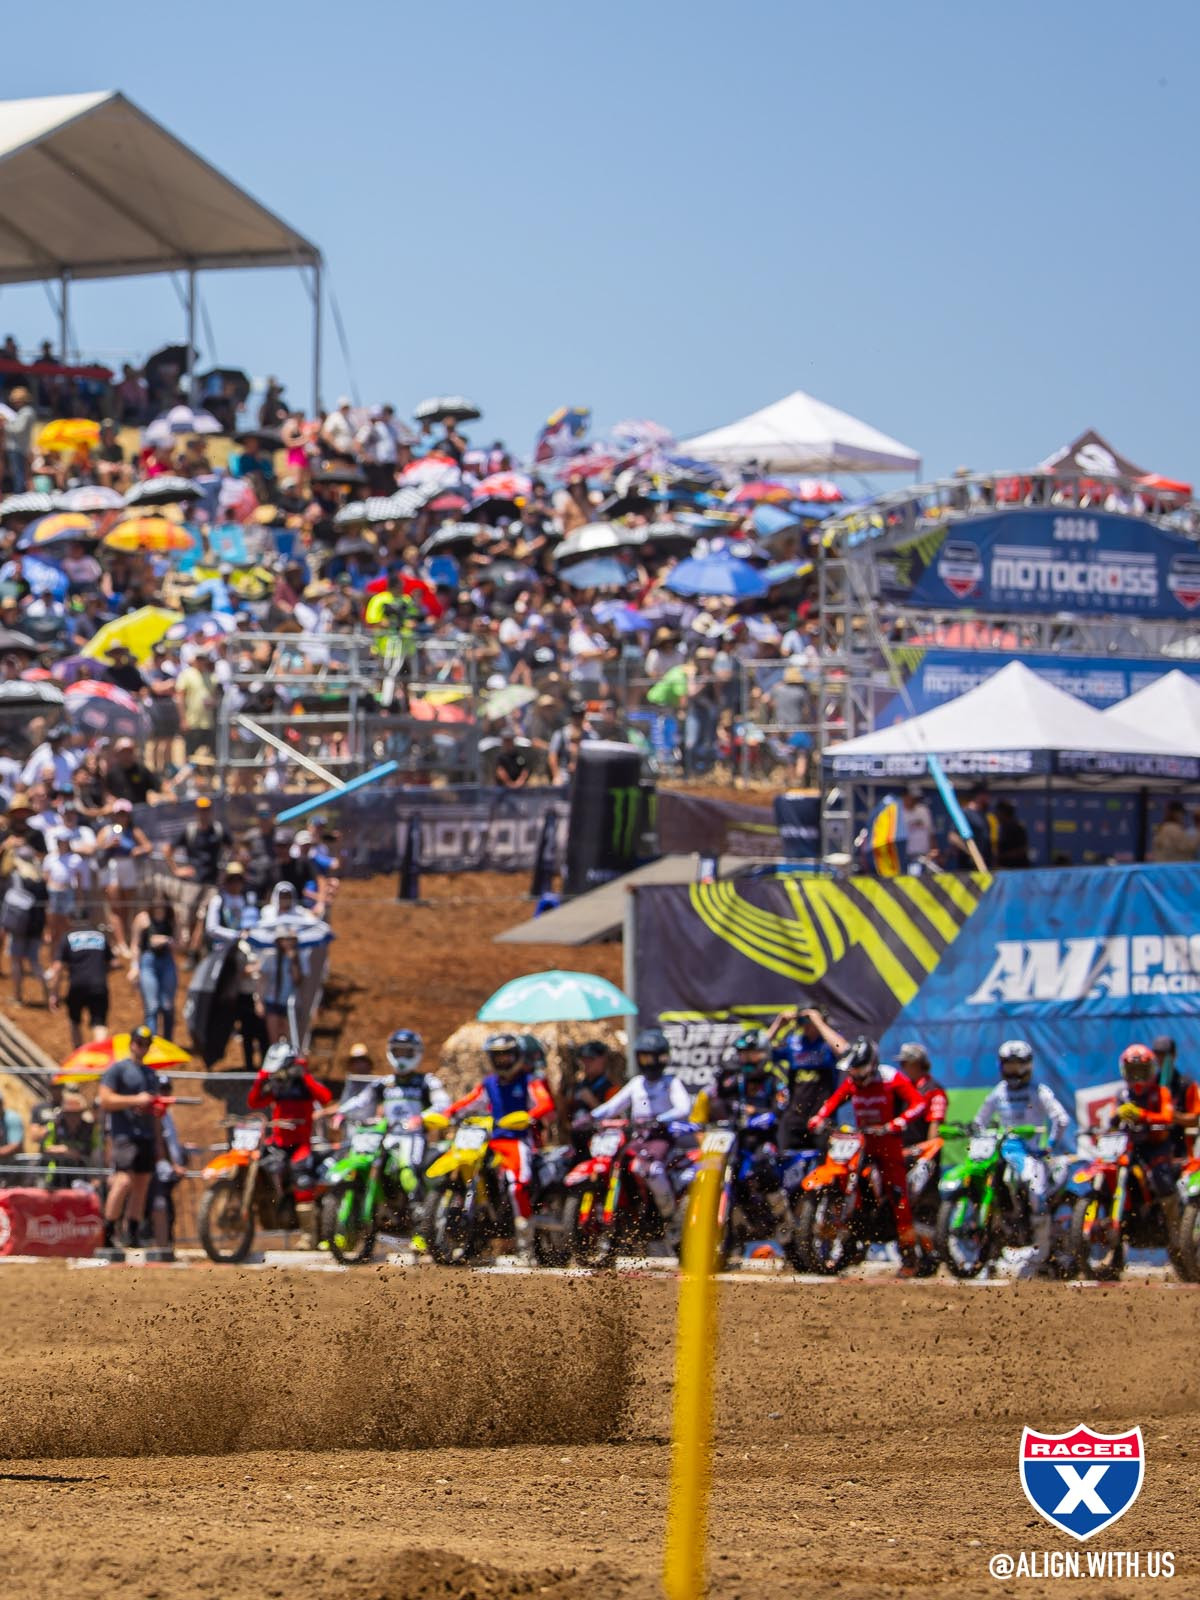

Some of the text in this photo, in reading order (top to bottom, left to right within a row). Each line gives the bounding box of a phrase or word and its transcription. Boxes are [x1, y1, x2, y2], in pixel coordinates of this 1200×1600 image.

[1053, 517, 1099, 541] 2024
[991, 558, 1158, 597] MOTOCROSS
[965, 934, 1129, 1005] AMA
